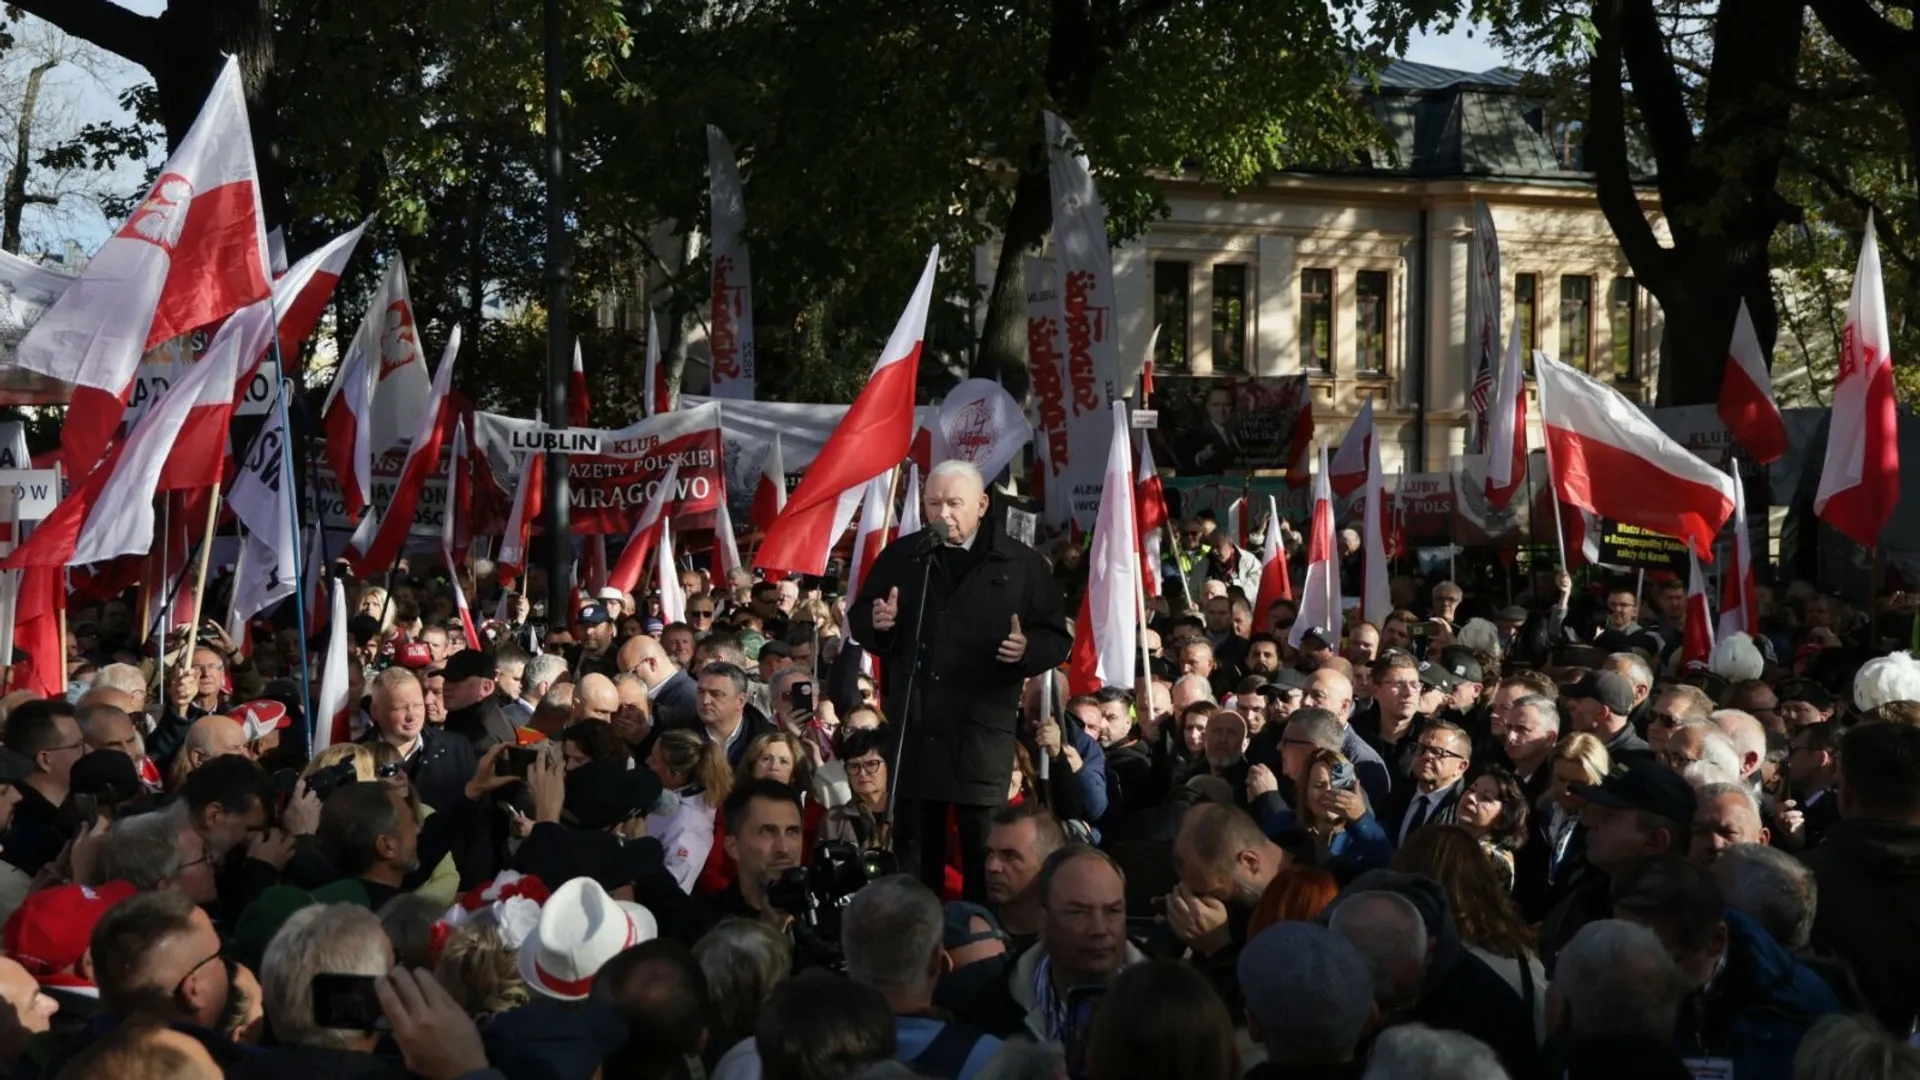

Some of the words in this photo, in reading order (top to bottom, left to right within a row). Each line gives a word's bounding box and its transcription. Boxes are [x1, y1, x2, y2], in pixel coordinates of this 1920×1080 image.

[513, 431, 597, 451] LUBLIN
[614, 435, 660, 454] KLUB
[568, 458, 629, 478] AZETY
[633, 449, 716, 474] POLSKIEJ
[1404, 480, 1440, 493] LUBY
